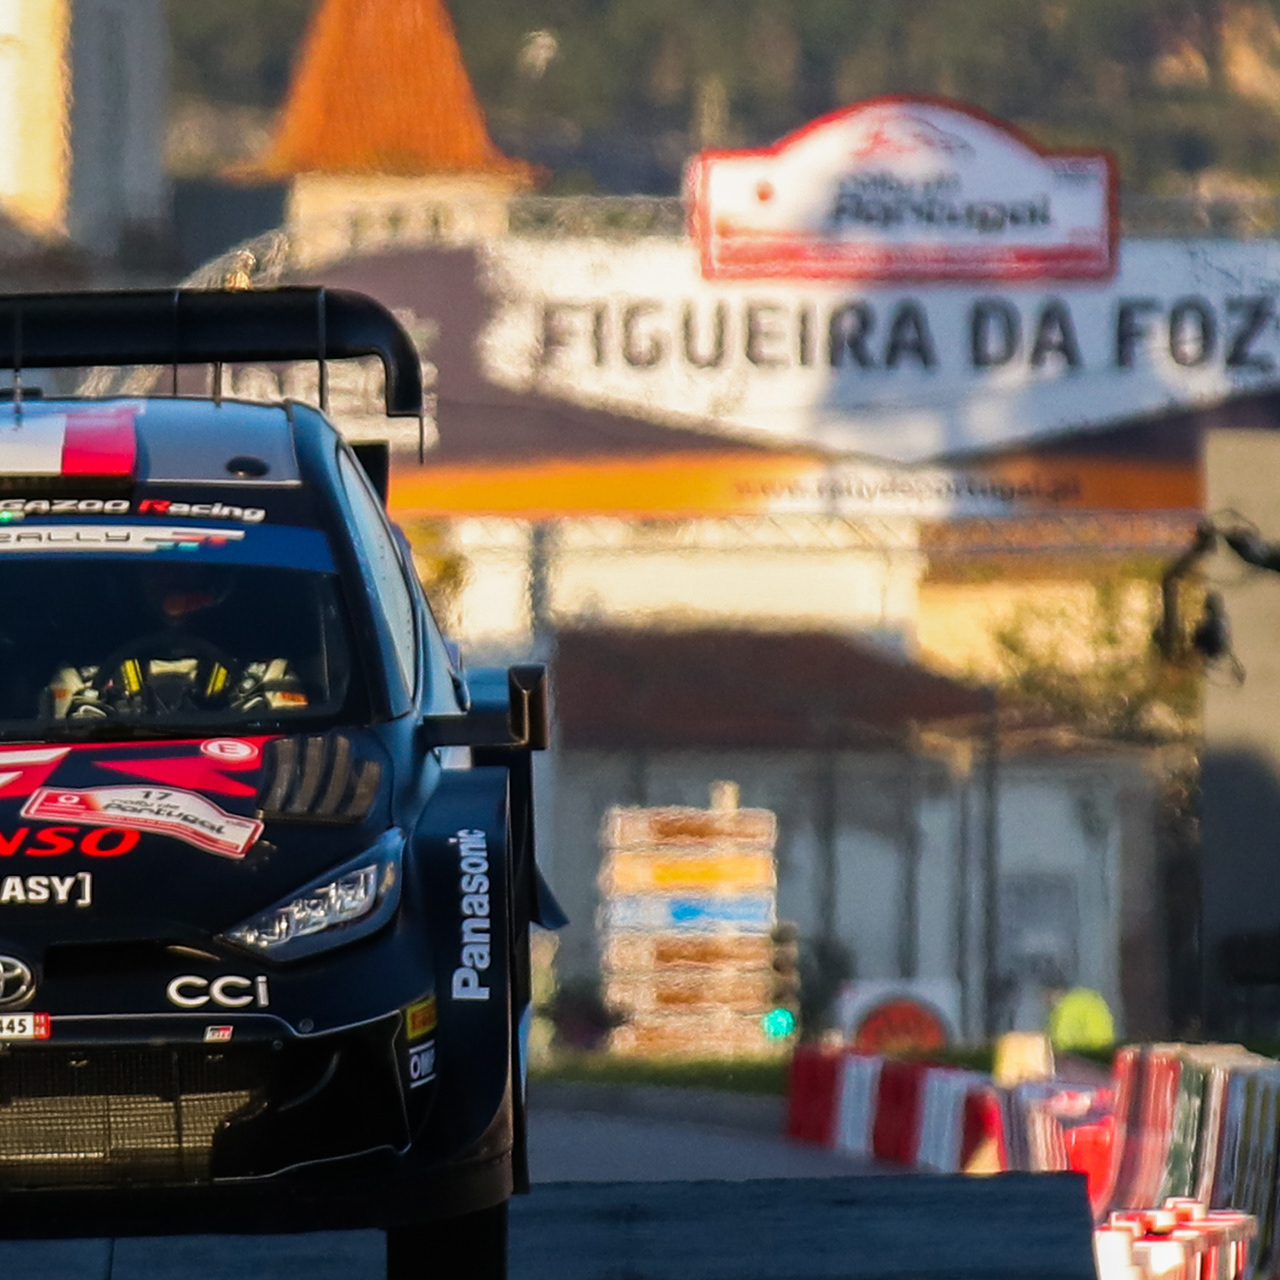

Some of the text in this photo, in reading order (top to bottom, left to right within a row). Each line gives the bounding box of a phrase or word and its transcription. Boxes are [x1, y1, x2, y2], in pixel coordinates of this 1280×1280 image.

[539, 294, 1277, 372] FIGUEIRA DA FOZ
[138, 500, 266, 523] Racing
[448, 828, 491, 1000] Panasonic
